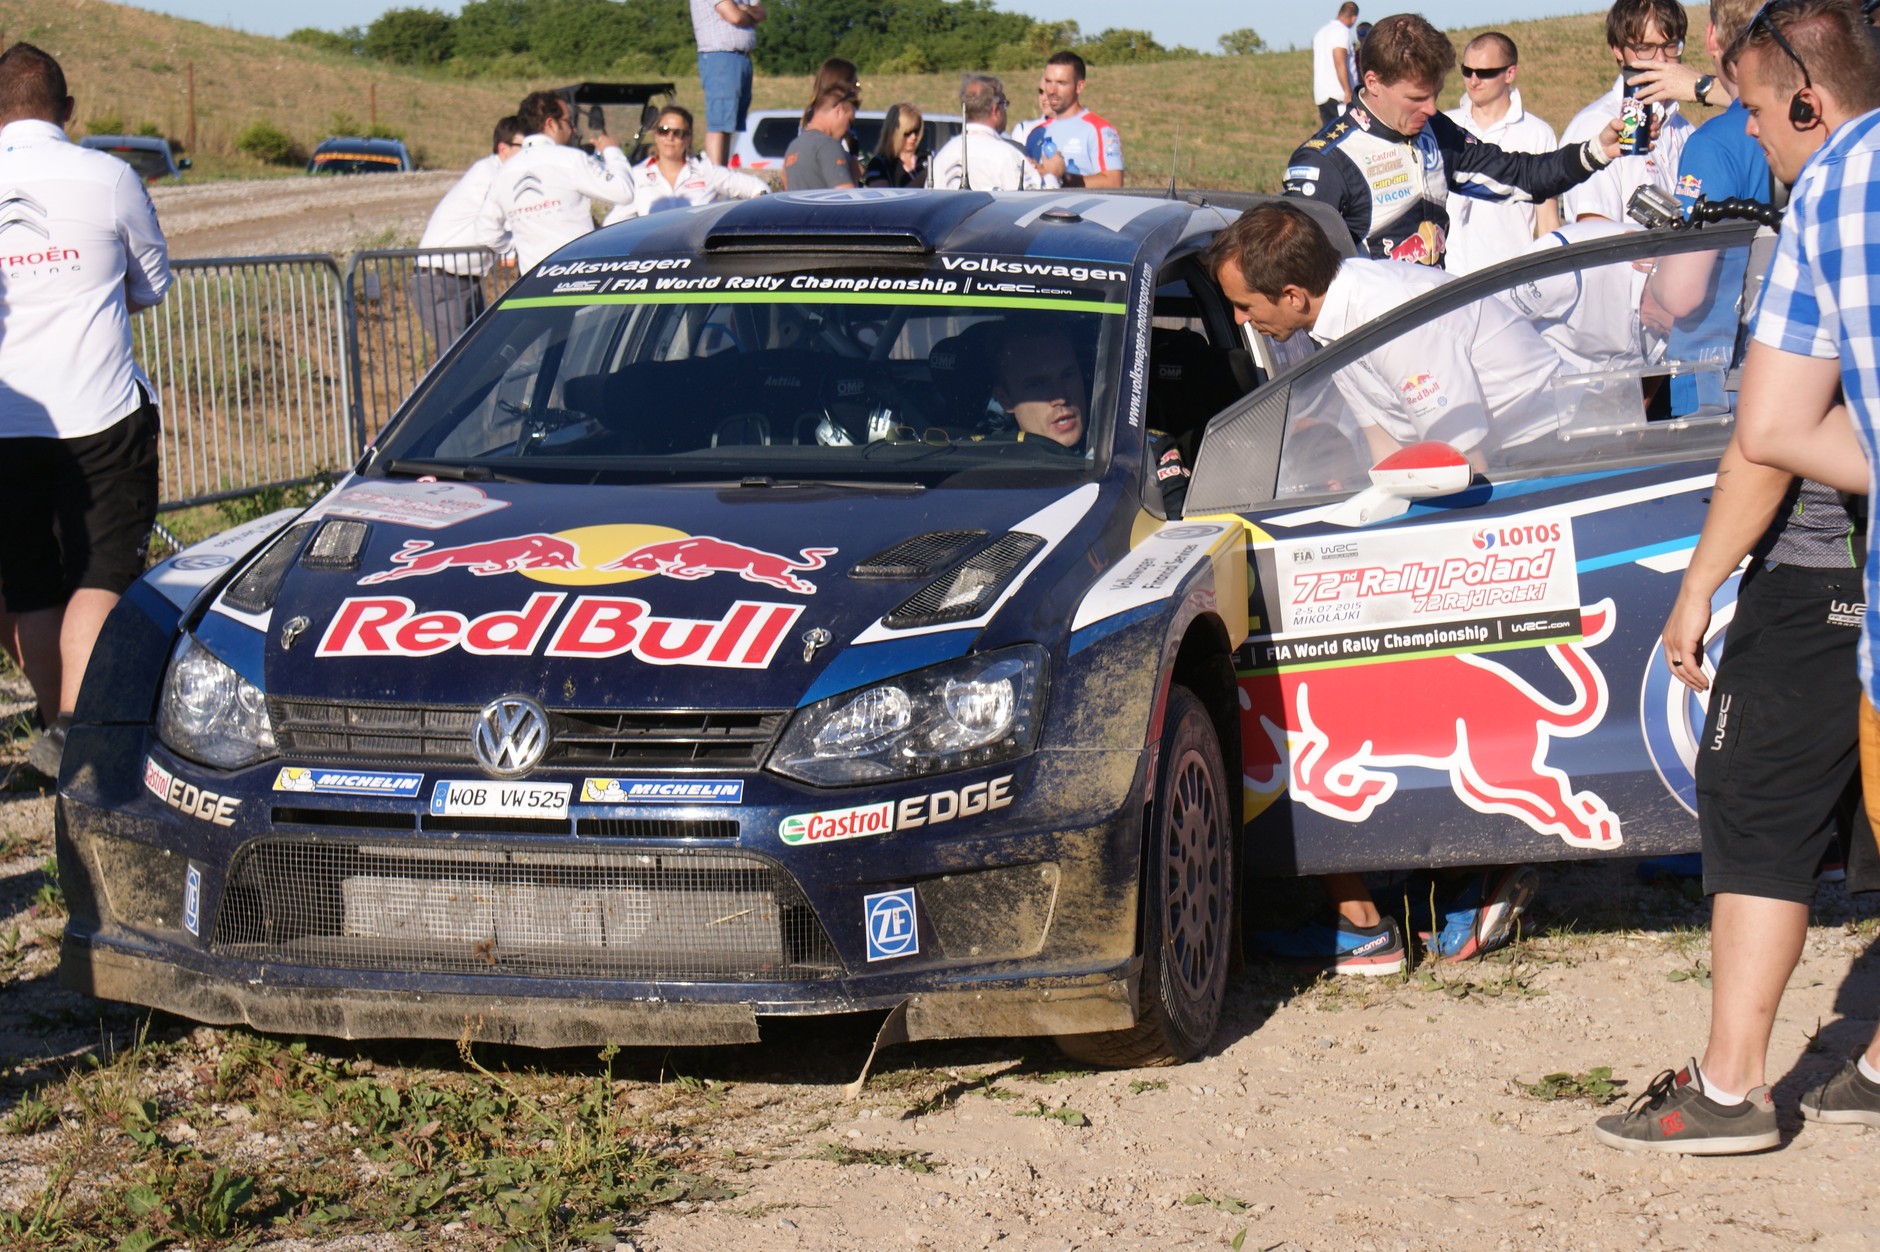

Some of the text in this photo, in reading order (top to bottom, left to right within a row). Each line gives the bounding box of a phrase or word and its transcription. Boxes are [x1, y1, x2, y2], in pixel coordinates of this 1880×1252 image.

[1371, 149, 1397, 163] Castrol
[1373, 173, 1408, 190] can-am
[1376, 187, 1411, 204] VACON
[536, 258, 691, 278] Volkswagen
[941, 256, 1127, 282] Volkswagen
[611, 277, 649, 292] FIA
[655, 276, 722, 290] World
[725, 275, 785, 291] Rally
[790, 275, 958, 293] Championship
[1128, 262, 1153, 428] www.volkswagen-motorsport.com
[837, 381, 864, 394] OMP
[1406, 382, 1440, 405] Red Bull
[1499, 523, 1560, 547] LOTOS
[1321, 543, 1358, 554] WRC
[1358, 562, 1439, 598] Rally
[1439, 548, 1556, 591] Poland
[1413, 583, 1547, 612] 72 Rajd Polski
[1293, 610, 1360, 626] MIKOŁAJKI
[318, 593, 802, 667] Red Bull
[1266, 645, 1292, 662] FIA
[1294, 641, 1340, 659] World
[1343, 637, 1380, 654] Rally
[1384, 624, 1489, 648] Championship
[1711, 693, 1732, 751] WRC
[317, 773, 420, 790] MICHELIN
[629, 783, 740, 796] MICHELIN
[144, 761, 243, 828] Castrol EDGE
[449, 788, 487, 806] WOB
[806, 773, 1015, 841] Castrol EDGE
[873, 905, 912, 944] ZF
